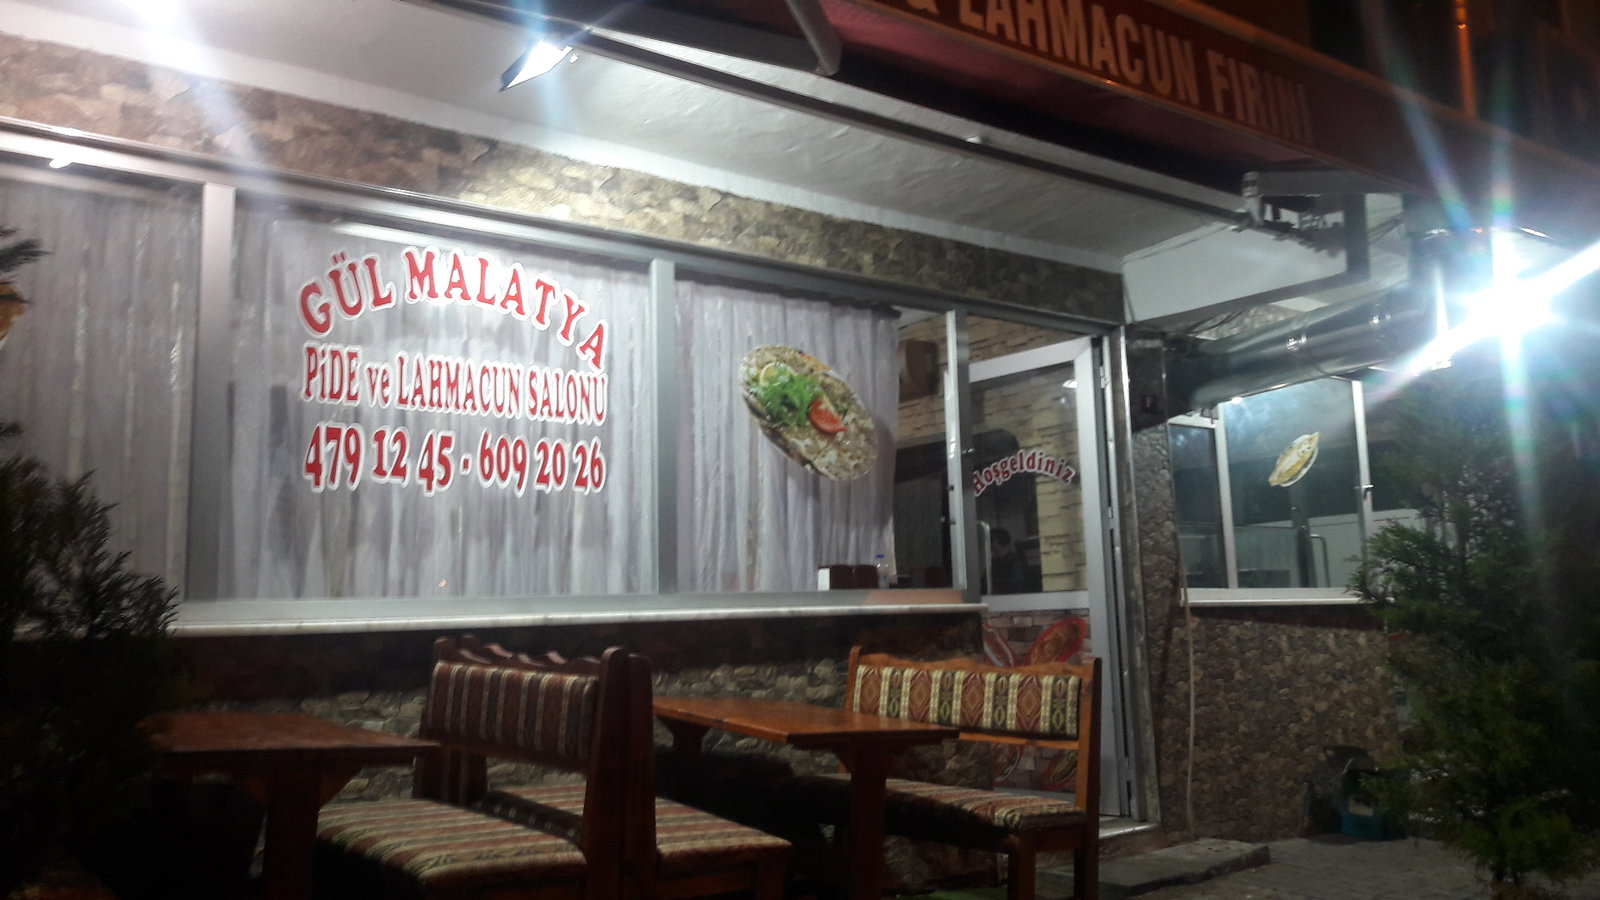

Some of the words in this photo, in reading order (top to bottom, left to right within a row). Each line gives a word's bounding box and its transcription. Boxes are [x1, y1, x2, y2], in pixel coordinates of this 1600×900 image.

[299, 250, 394, 334] GÜL
[404, 249, 606, 370] MALATYA
[366, 364, 390, 405] ve
[397, 355, 521, 415] LAHMACUN
[528, 368, 607, 422] SALONU
[303, 423, 363, 488] 479
[371, 427, 409, 482] 12
[417, 431, 454, 491] 45
[478, 430, 528, 490] 609
[535, 439, 567, 489] 20
[573, 440, 603, 489] 26
